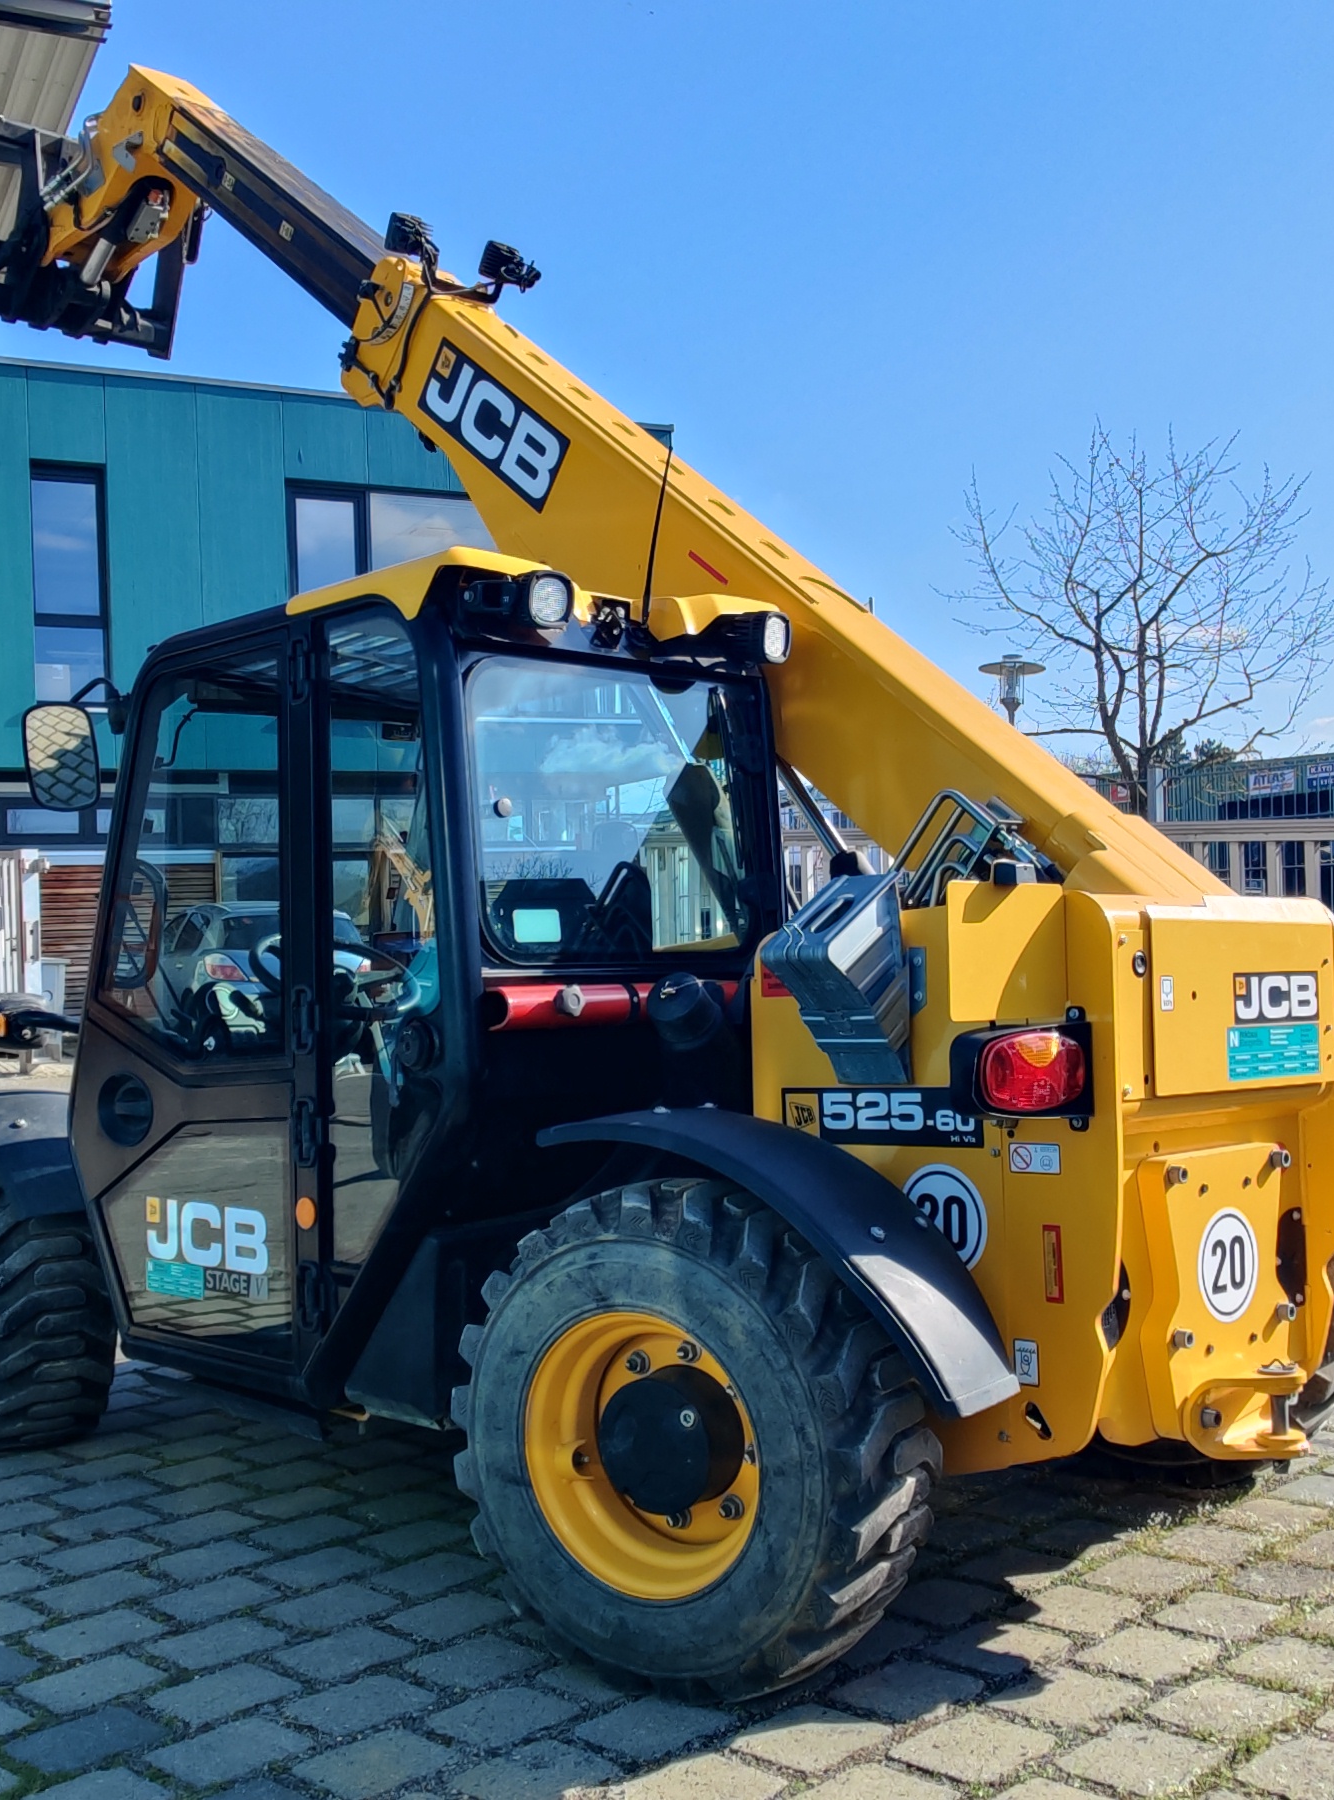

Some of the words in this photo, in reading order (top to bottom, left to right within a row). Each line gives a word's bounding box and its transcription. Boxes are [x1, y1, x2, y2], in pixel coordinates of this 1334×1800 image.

[425, 362, 561, 499] JCB
[1253, 771, 1286, 786] ATLAS
[1235, 975, 1318, 1020] JCB
[794, 1104, 815, 1126] JCB
[147, 1199, 269, 1275] JCB
[205, 1270, 249, 1295] STAGE
[1211, 1235, 1246, 1295] 20
